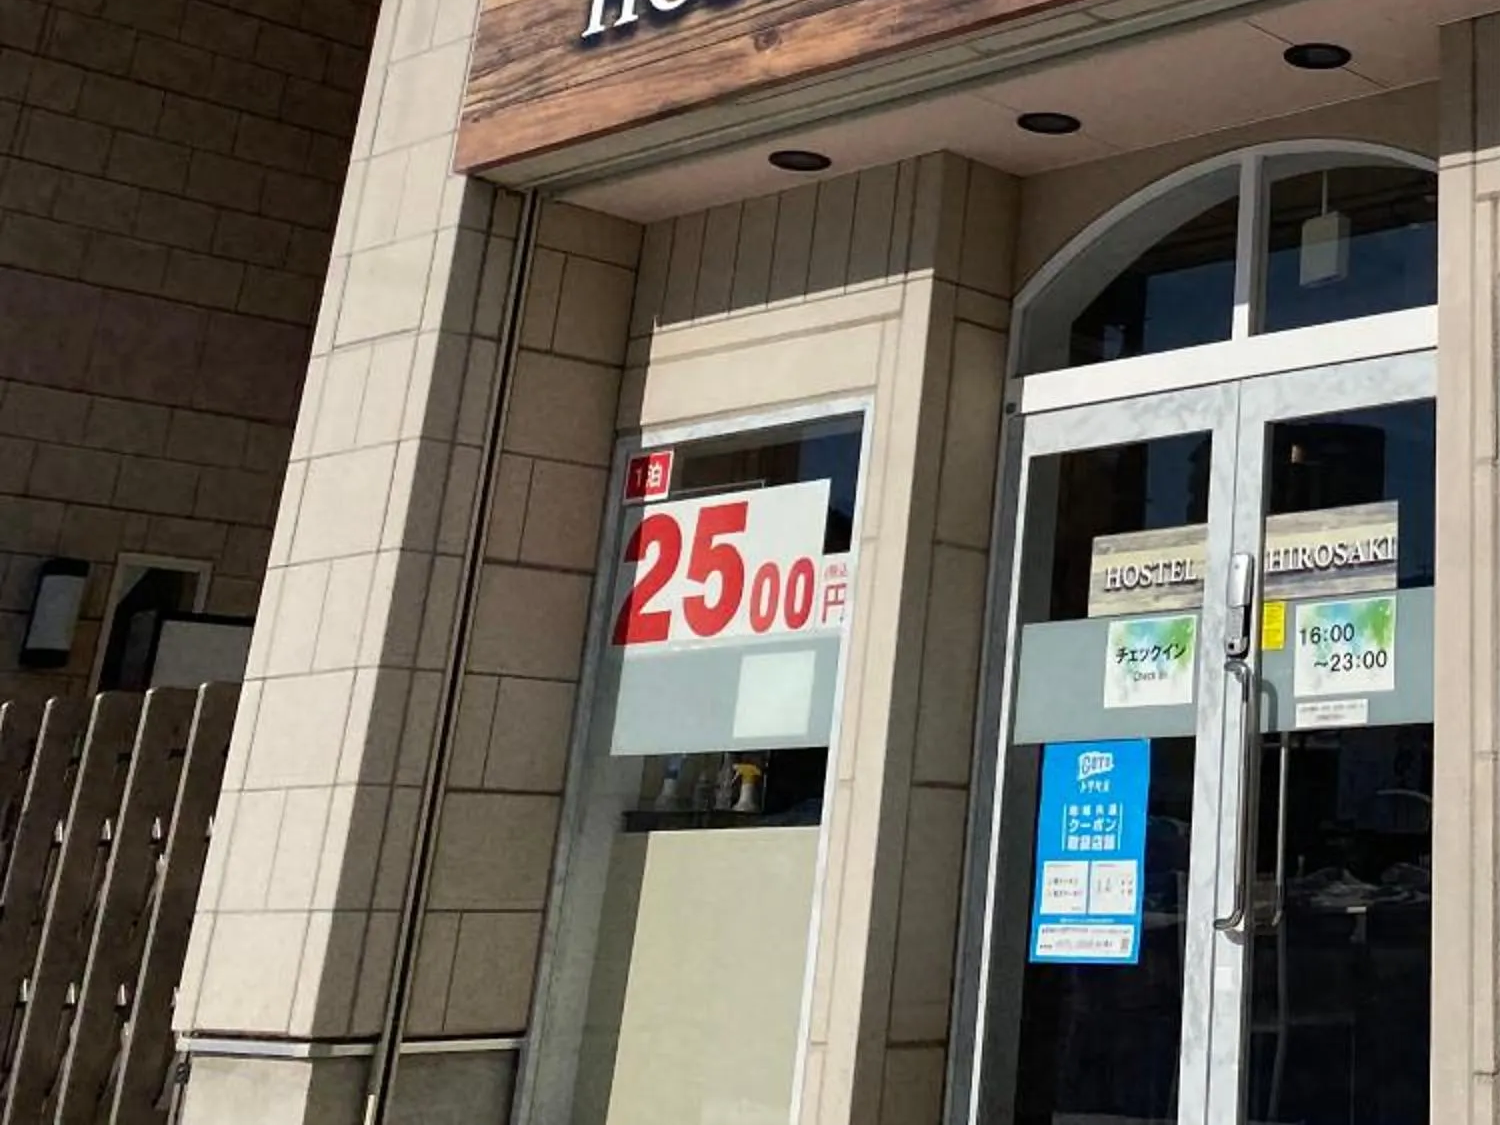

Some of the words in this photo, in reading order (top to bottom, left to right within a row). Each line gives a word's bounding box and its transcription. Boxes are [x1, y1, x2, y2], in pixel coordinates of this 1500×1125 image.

[1104, 557, 1199, 591] HOSTEL
[1266, 535, 1396, 573] HIROSAKI
[1299, 622, 1355, 647] 16:00
[1116, 642, 1187, 664] チェックイン
